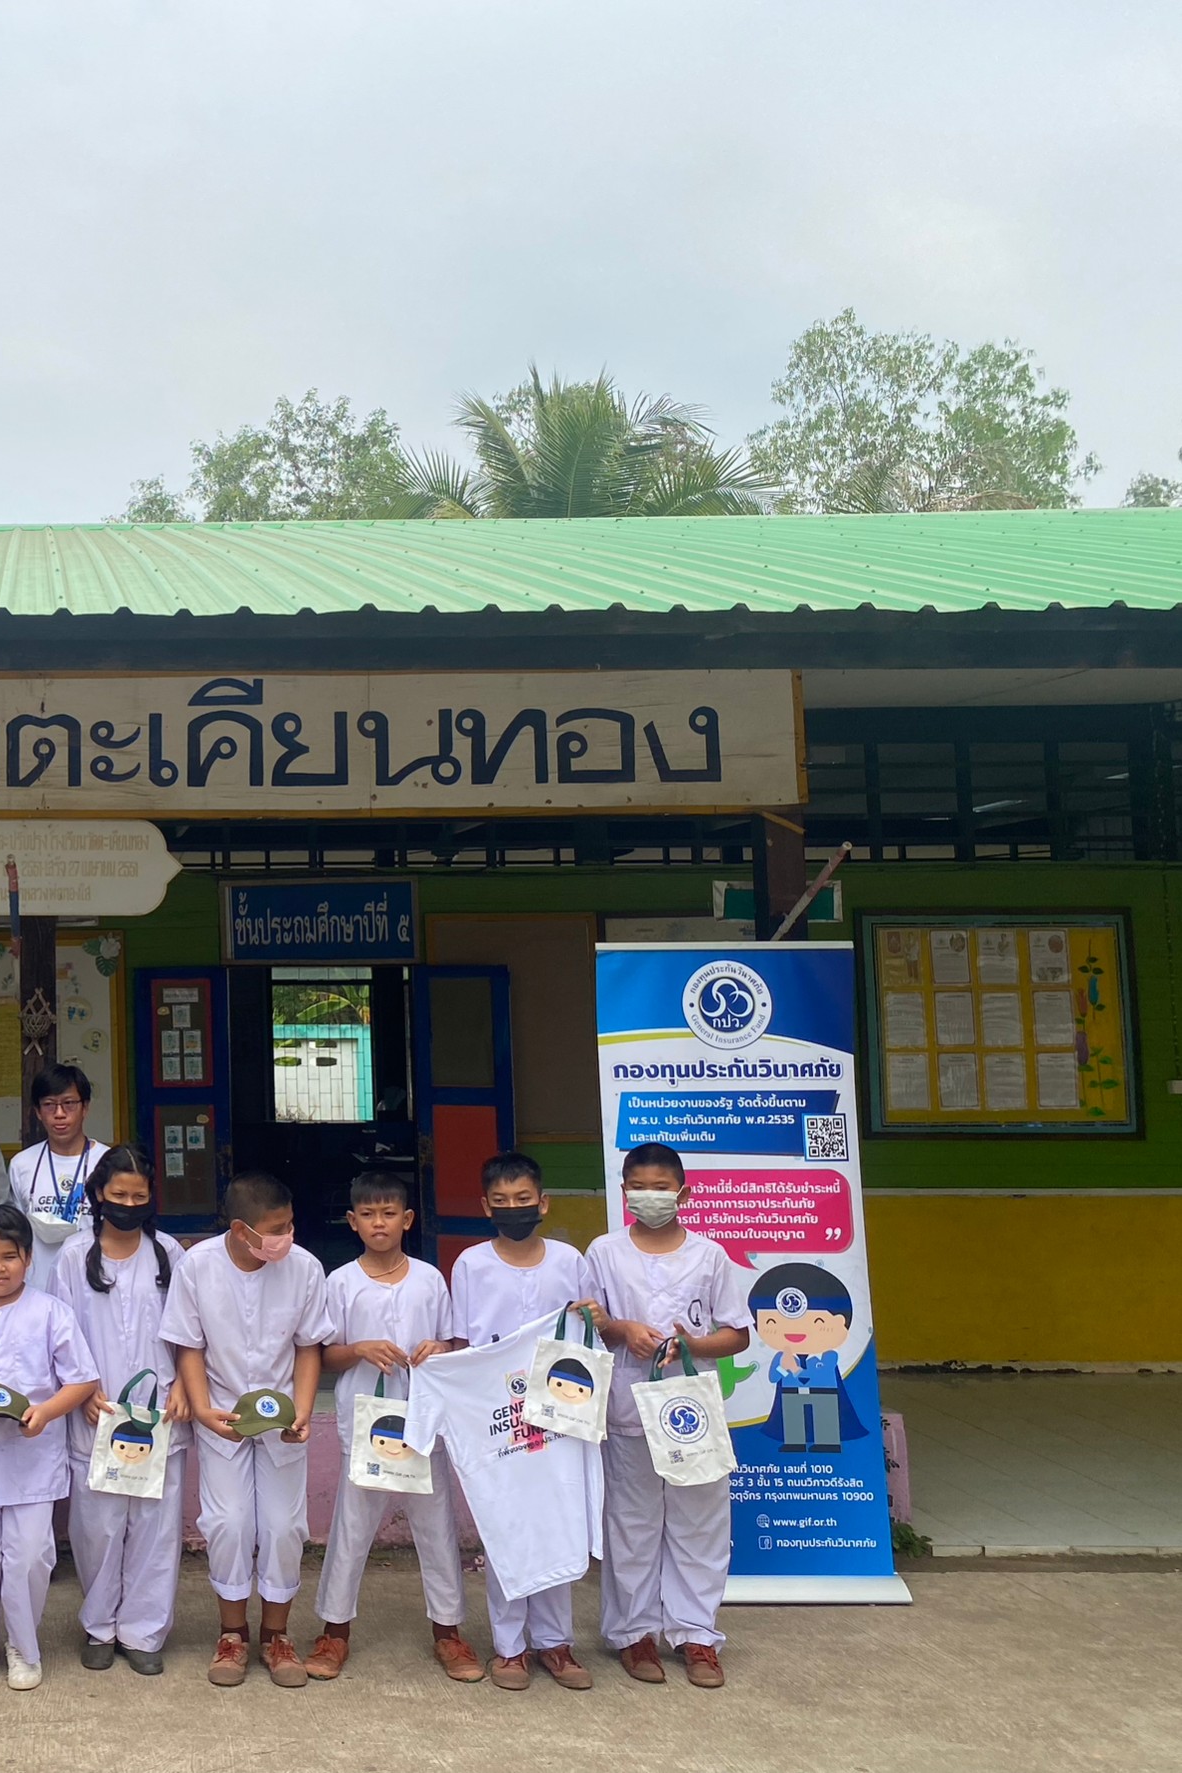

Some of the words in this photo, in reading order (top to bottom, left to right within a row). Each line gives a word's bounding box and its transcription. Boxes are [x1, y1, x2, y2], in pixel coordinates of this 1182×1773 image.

[234, 891, 389, 946] ชั้นประถมศึกษาปีที่
[712, 1014, 744, 1029] กปว.
[691, 1014, 714, 1040] General
[715, 1032, 753, 1045] Insurance
[750, 1014, 766, 1033] Fund
[613, 1057, 842, 1086] กองทุนประกันวินาศภัย
[628, 1093, 733, 1111] เป็นหน่วยงานของรัฐ
[737, 1090, 806, 1109] จัดตั้งขึ้นตาม
[629, 1115, 661, 1126] พ.ร.บ.
[665, 1112, 741, 1126] ประกันวินาศภัย
[745, 1114, 795, 1126] พ.ศ.2535
[630, 1129, 716, 1143] และแก้ไขเพิ่มเติม
[704, 1212, 818, 1225] บริษัทประกันวินาศภัย
[784, 1461, 807, 1474] เลขที่
[811, 1464, 833, 1474] 1010
[747, 1478, 754, 1487] 3
[757, 1474, 770, 1487] ชั้น
[774, 1478, 784, 1487] 15
[787, 1477, 863, 1488] ถนนวิภาวดีรังสิต
[765, 1491, 838, 1503] กรุงเทพมหานคร
[842, 1492, 874, 1501] 10900
[773, 1517, 837, 1528] www.gif.or.th
[776, 1537, 877, 1550] กองทุนประกันวินาศภัย
